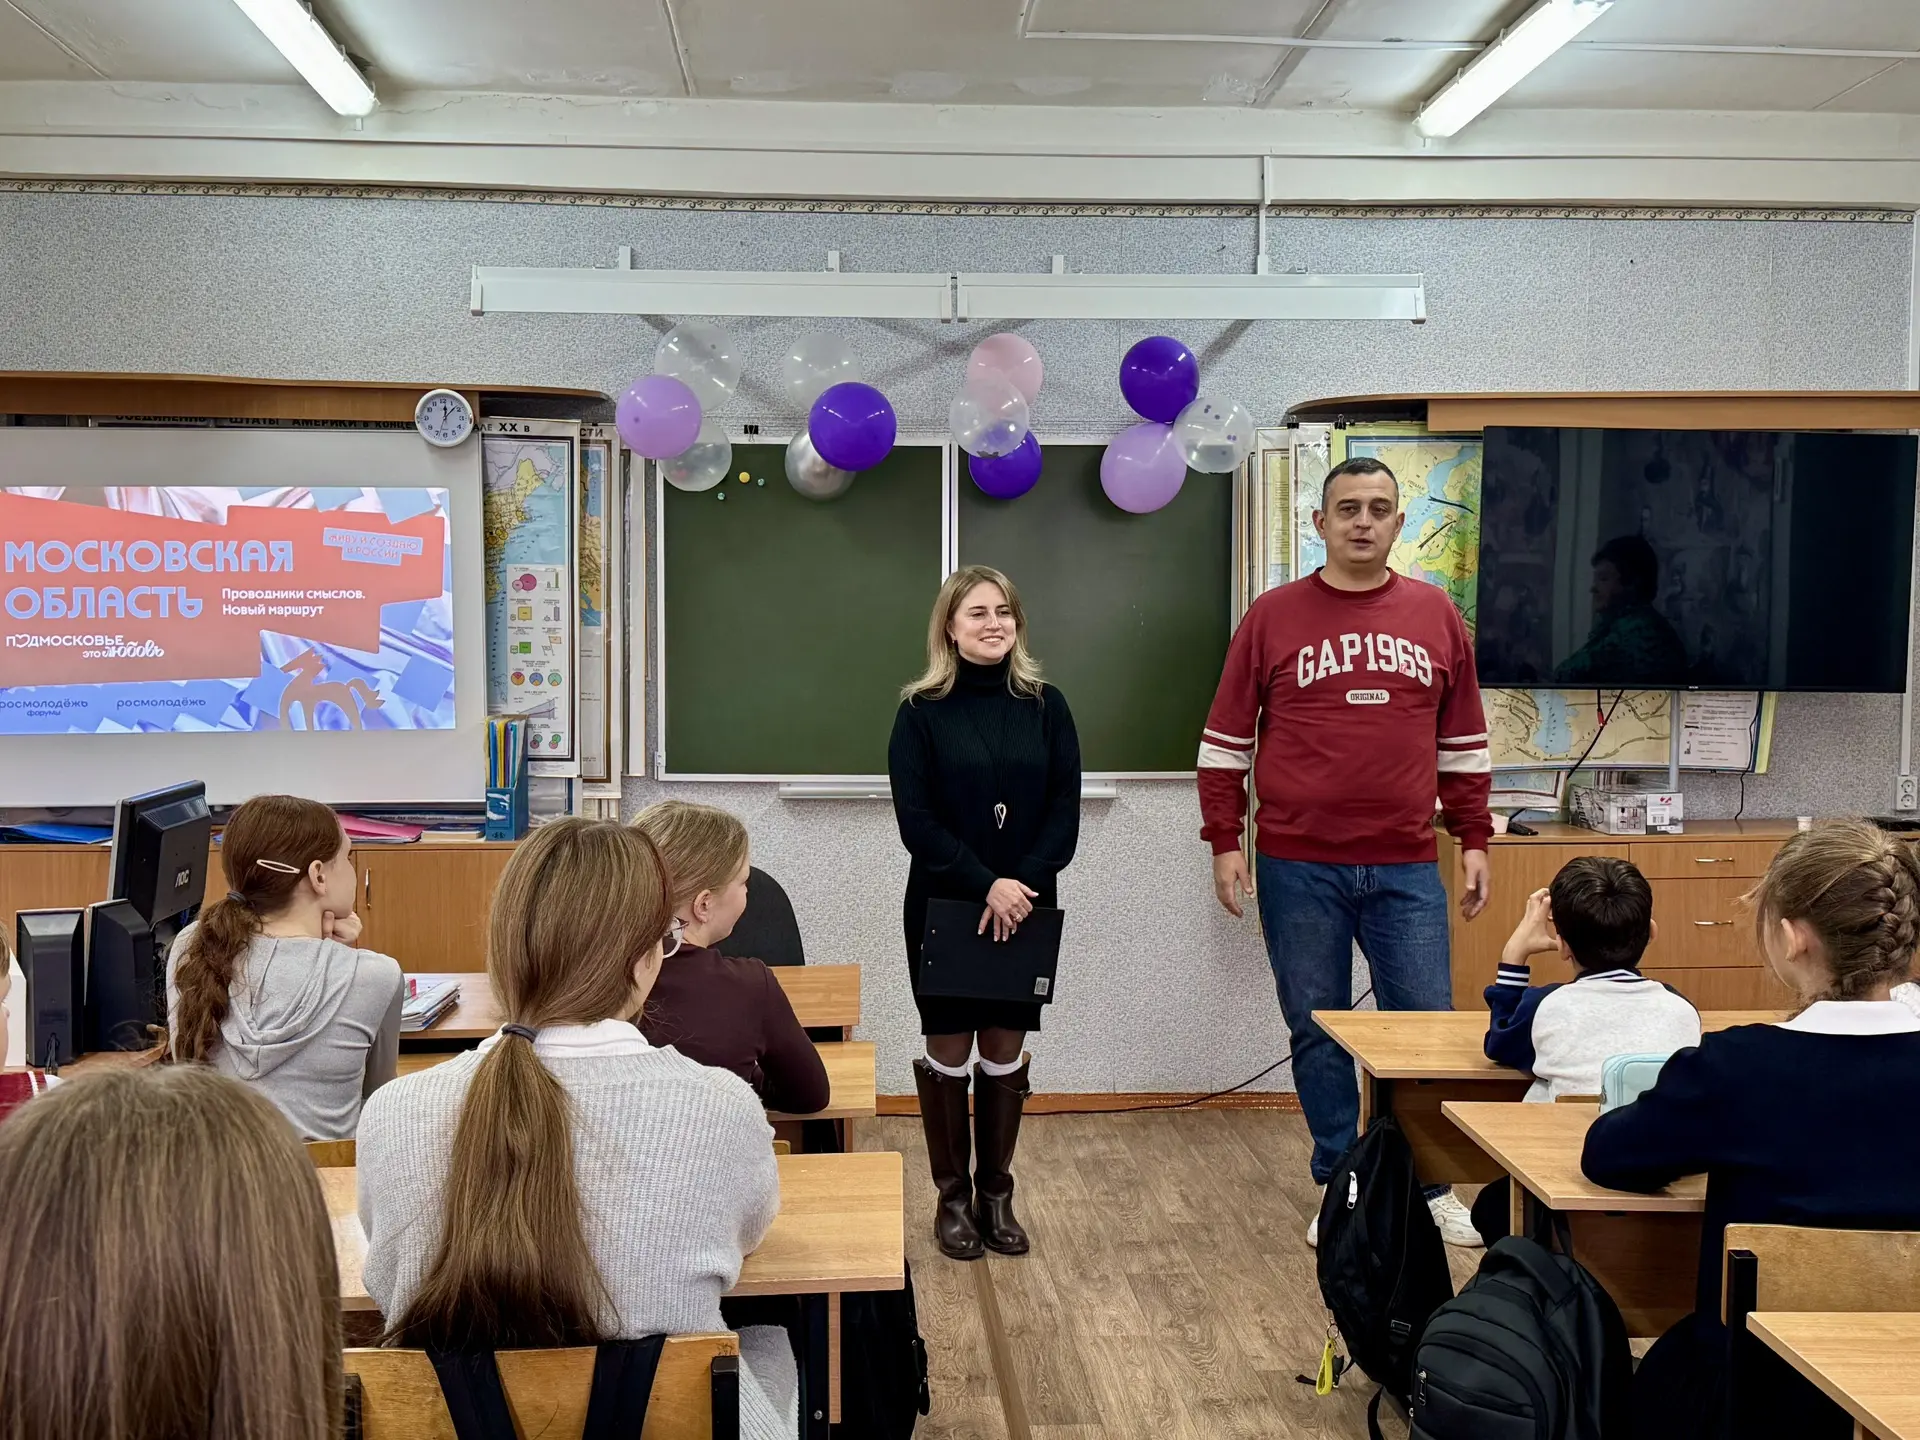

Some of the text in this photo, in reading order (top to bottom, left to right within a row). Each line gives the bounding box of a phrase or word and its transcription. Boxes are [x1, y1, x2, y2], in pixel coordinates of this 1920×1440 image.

[579, 428, 604, 437] СТИ
[5, 539, 294, 573] МОСКОВСКАЯ
[221, 588, 366, 602] Проводники смыслов.
[4, 586, 203, 619] ОБЛАСТЬ
[222, 603, 325, 617] Новый маршрут
[1350, 692, 1386, 701] ORIGINAL
[116, 697, 207, 711] росмолодёжь
[26, 709, 62, 718] форумы
